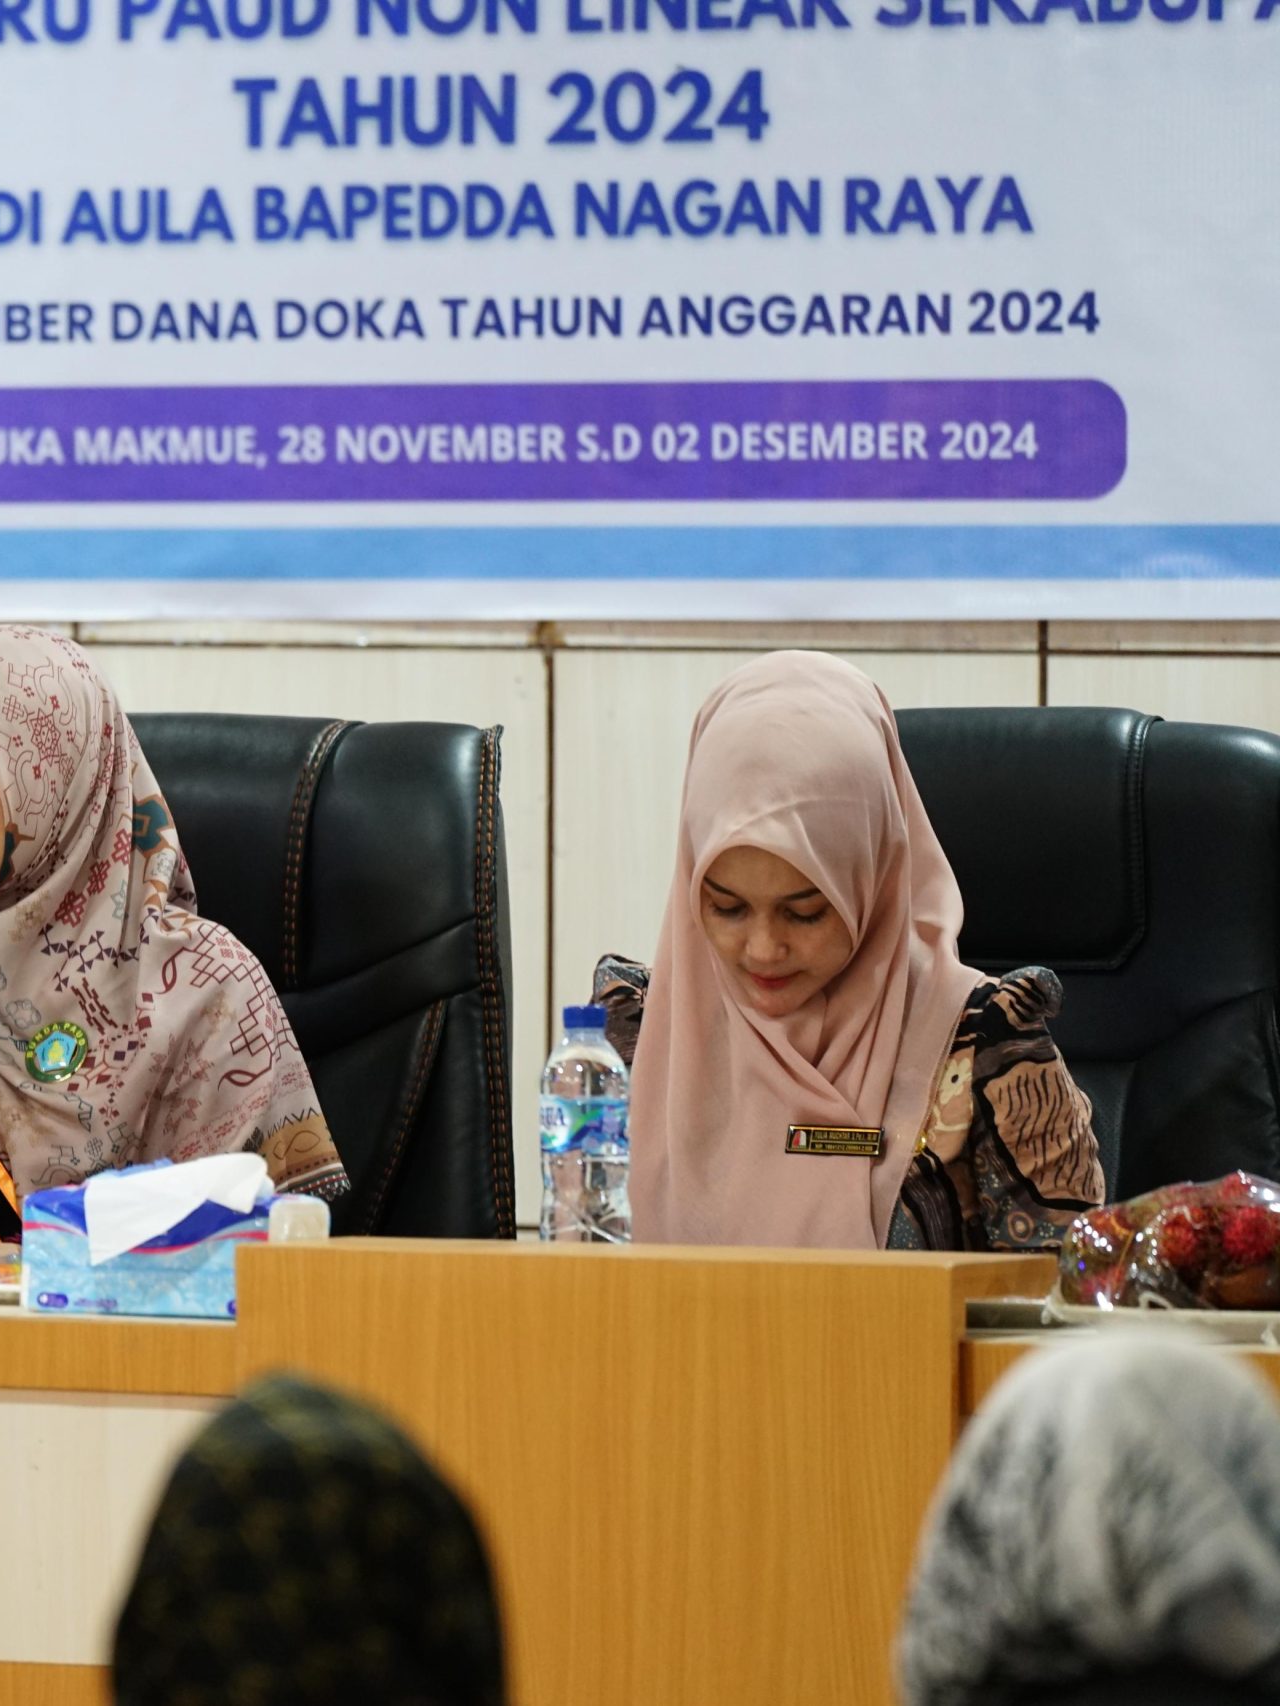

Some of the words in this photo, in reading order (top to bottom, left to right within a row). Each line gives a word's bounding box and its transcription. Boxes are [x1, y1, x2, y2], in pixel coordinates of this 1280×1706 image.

[117, 0, 332, 43] PAUD
[354, 0, 540, 37] NON
[233, 72, 518, 149] TAHUN
[547, 67, 771, 146] 2024
[62, 187, 236, 246] AULA
[254, 182, 556, 244] BAPEDDA
[574, 177, 822, 240] NAGAN
[844, 174, 1035, 237] RAYA
[111, 301, 259, 343] DANA
[276, 299, 425, 341] DOKA
[441, 297, 623, 340] TAHUN
[638, 293, 952, 338] ANGGARAN
[967, 289, 1101, 335] 2024
[73, 425, 268, 469] MAKMUE,
[277, 424, 327, 465] 28
[335, 423, 567, 465] NOVEMBER
[576, 423, 642, 463] S.D
[651, 422, 700, 462] 02
[710, 421, 929, 461] DESEMBER
[940, 421, 1039, 460] 2024
[26, 1022, 60, 1059] BUNDA
[63, 1021, 86, 1047] PAUD
